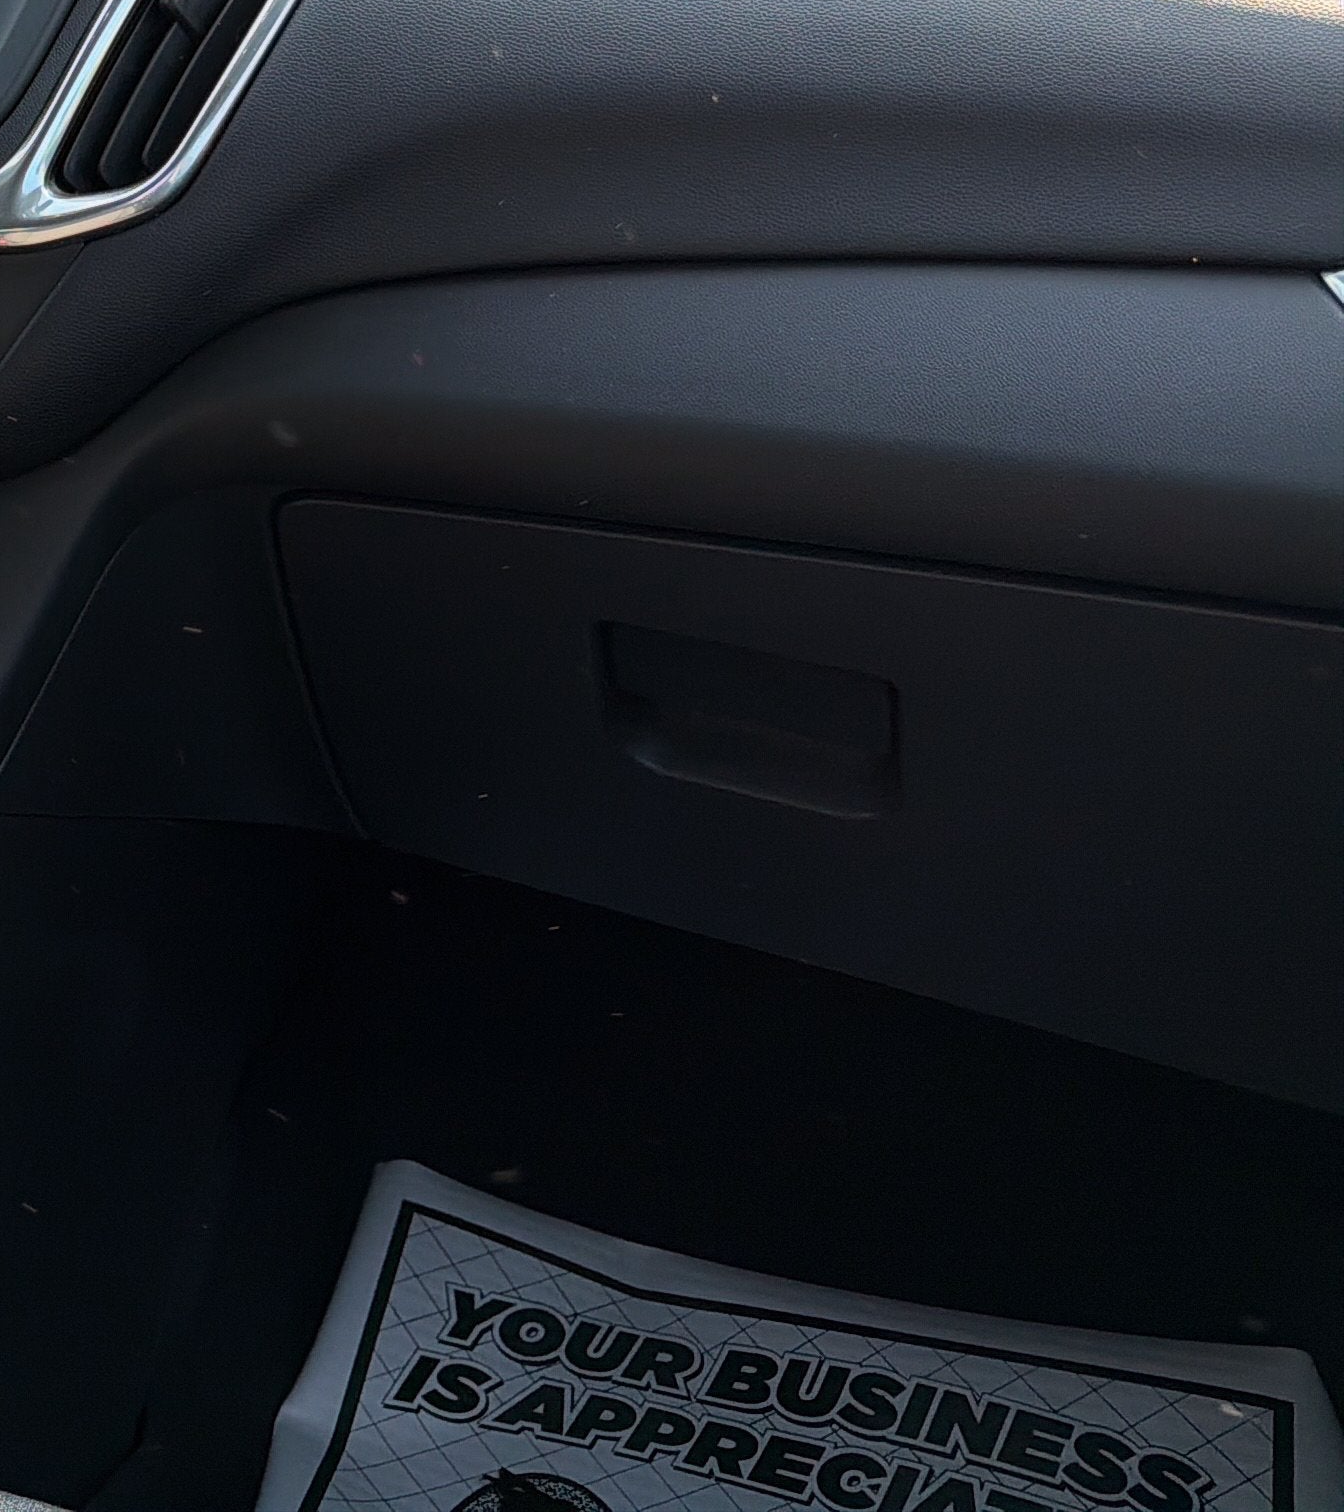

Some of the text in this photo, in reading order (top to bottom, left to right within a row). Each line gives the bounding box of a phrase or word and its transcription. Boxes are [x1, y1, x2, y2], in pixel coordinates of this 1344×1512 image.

[391, 1355, 489, 1416] IS
[444, 1289, 1204, 1512] YOUR BUSINESS
